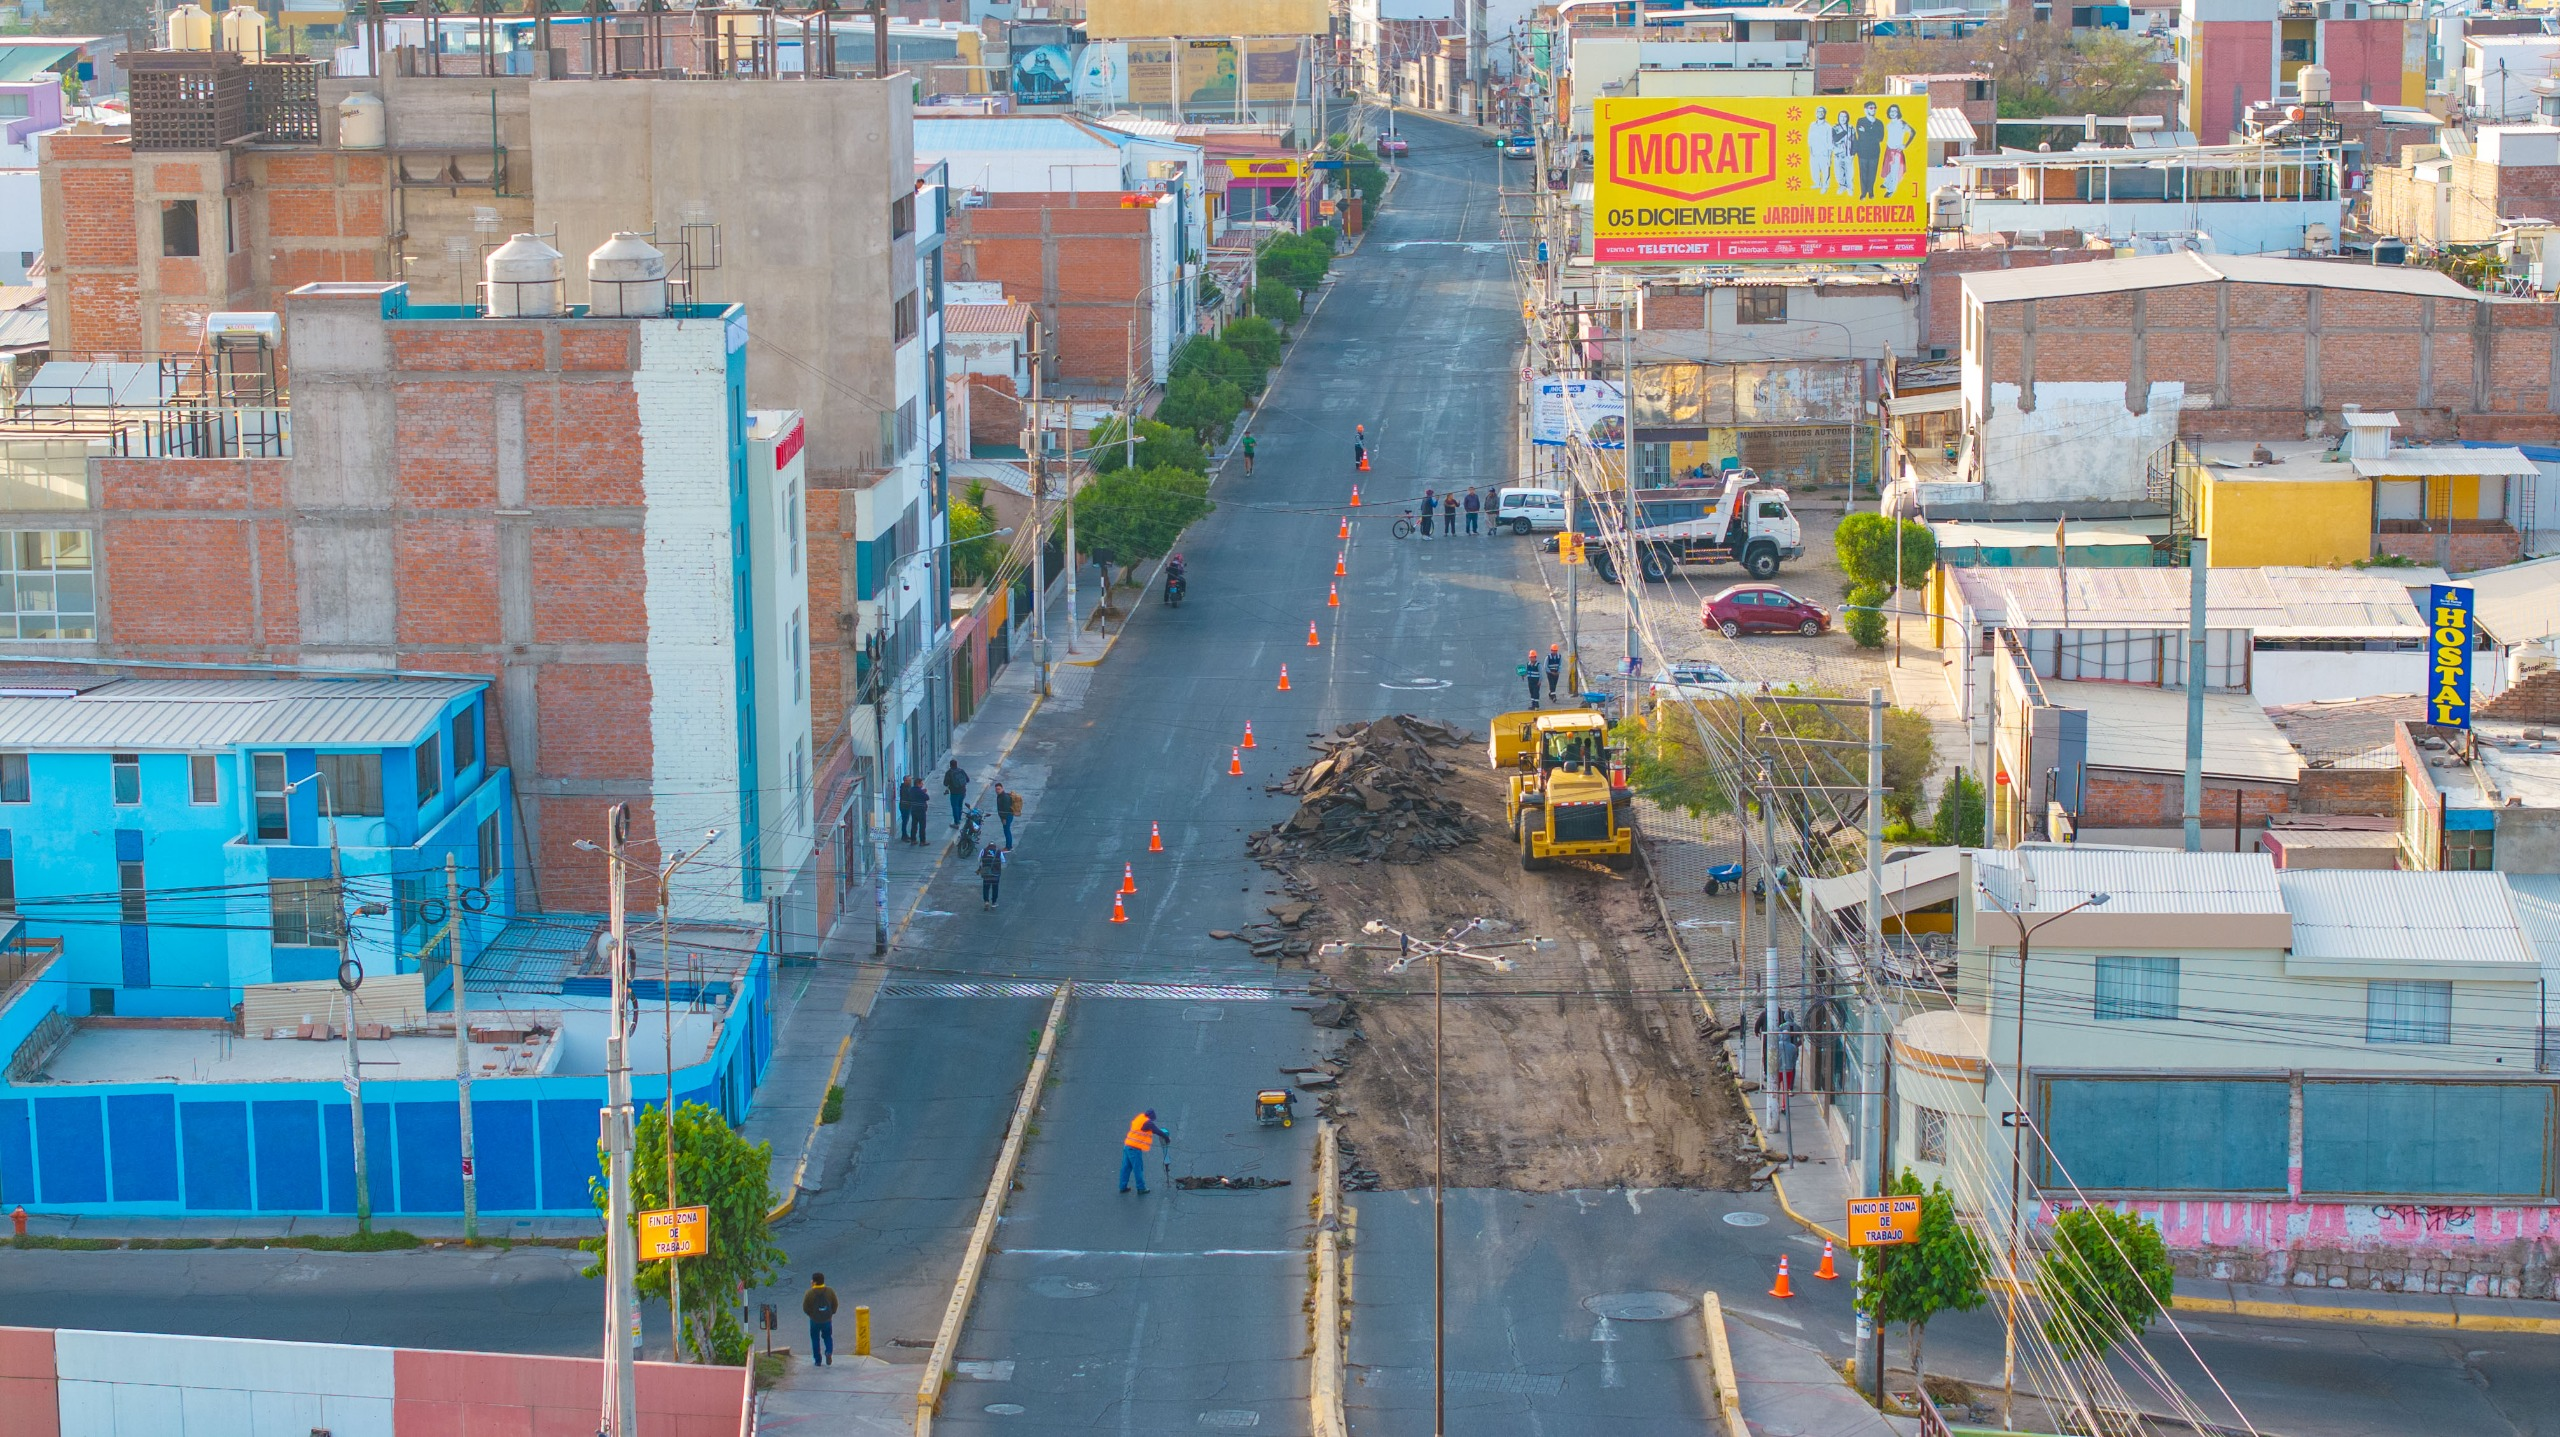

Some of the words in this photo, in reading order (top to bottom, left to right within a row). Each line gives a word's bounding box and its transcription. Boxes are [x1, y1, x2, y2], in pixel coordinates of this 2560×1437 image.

[1627, 132, 1760, 176] MORAT
[1607, 209, 1634, 227] 05
[1638, 206, 1756, 226] DICIEMBRE
[1762, 203, 1815, 224] JARDÍN
[1818, 206, 1834, 224] DE
[1837, 206, 1854, 224] LA
[1856, 205, 1915, 224] CERVEZA
[1638, 244, 1709, 254] TELETICKET
[1740, 430, 1812, 439] MULTISERVICIOS
[1814, 426, 1870, 436] AUTOMORIZ
[2432, 607, 2467, 725] HOSTAL
[1852, 1204, 1876, 1214] INICIO
[1880, 1202, 1890, 1212] DE
[1894, 1202, 1916, 1212] ZONA
[649, 1216, 661, 1226] FIN
[664, 1215, 673, 1225] DE
[677, 1212, 698, 1224] ZONA
[1880, 1216, 1890, 1226] DE
[670, 1228, 678, 1238] DE
[1866, 1230, 1903, 1241] TRABAJO
[656, 1240, 690, 1253] TRABAJO
